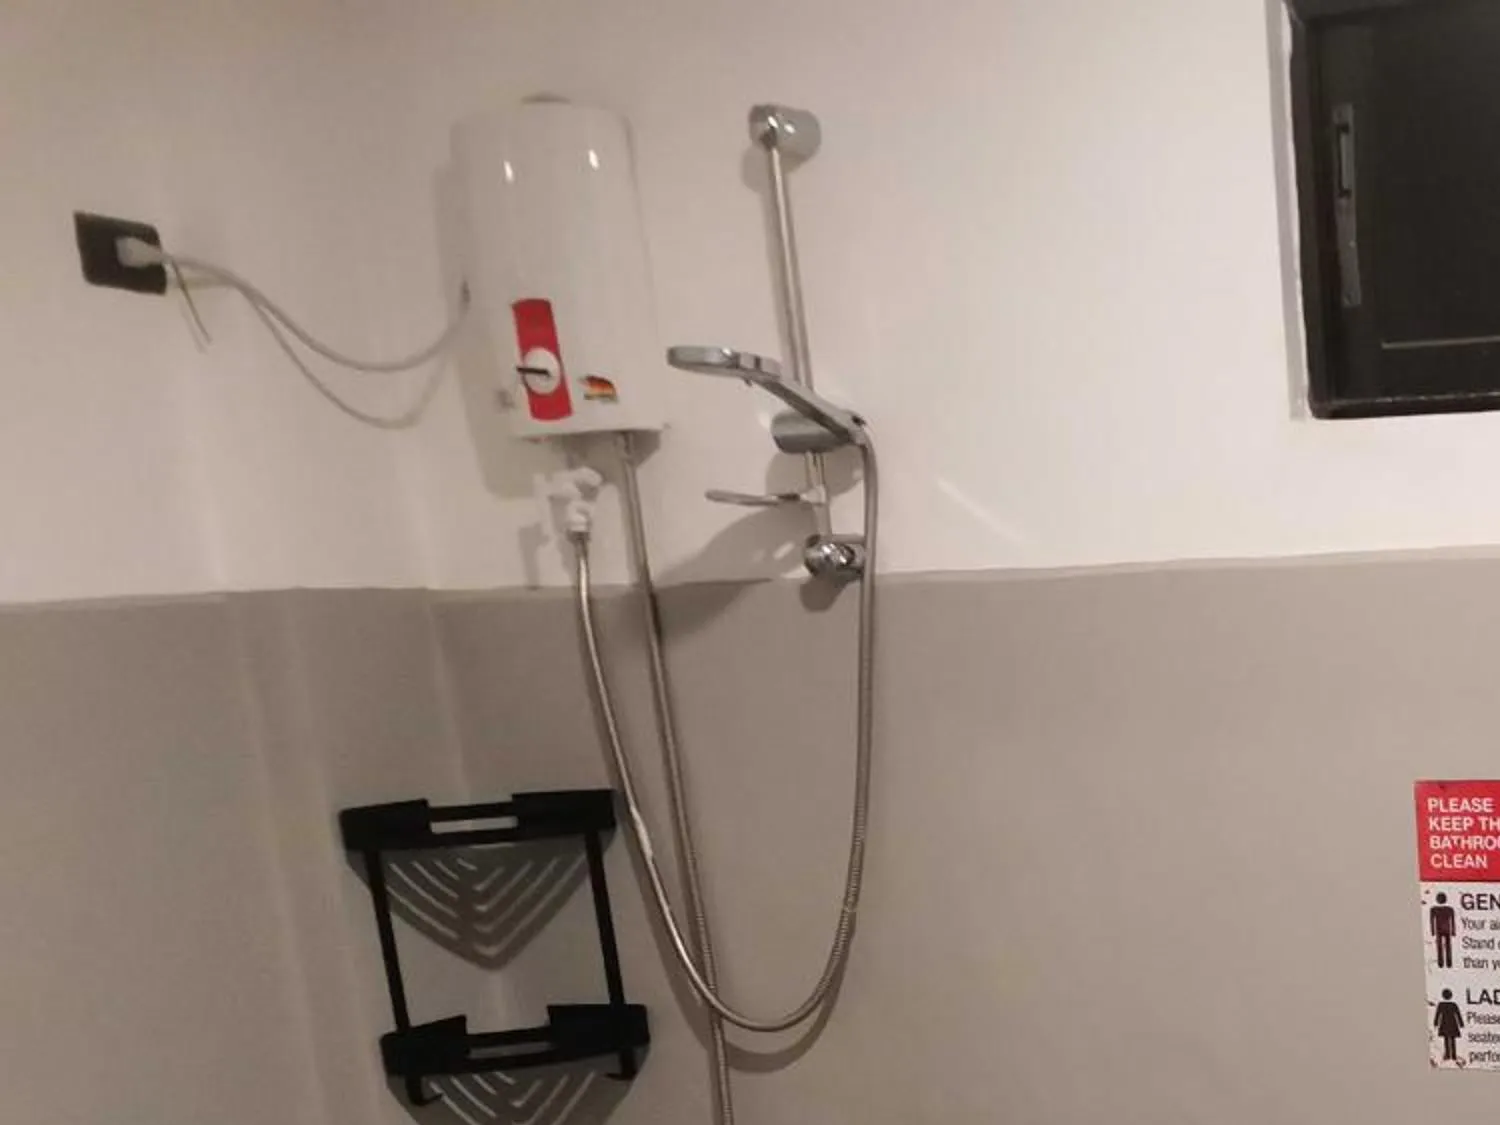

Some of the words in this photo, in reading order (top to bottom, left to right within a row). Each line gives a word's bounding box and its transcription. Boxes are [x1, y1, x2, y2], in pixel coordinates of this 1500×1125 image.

[1427, 797, 1494, 813] PLEASE
[1428, 816, 1474, 831] KEEP
[1430, 854, 1488, 869] CLEAN
[1461, 918, 1486, 931] Your
[1461, 936, 1495, 950] Stand
[1463, 957, 1489, 969] than
